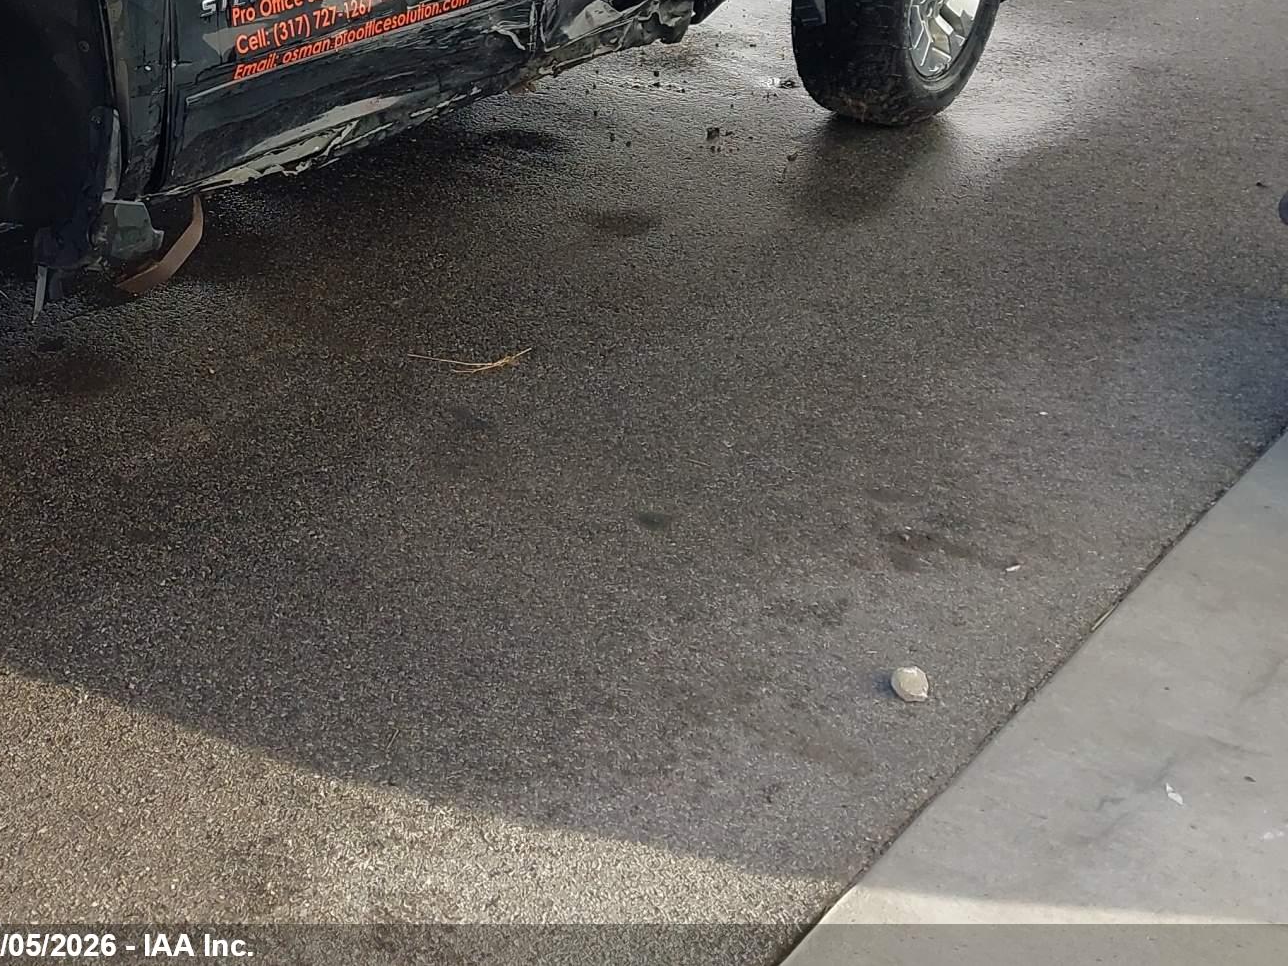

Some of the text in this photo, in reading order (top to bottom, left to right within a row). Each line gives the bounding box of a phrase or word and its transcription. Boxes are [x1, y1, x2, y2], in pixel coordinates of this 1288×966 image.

[232, 6, 256, 27] Pro
[236, 27, 270, 54] Cell:
[272, 13, 310, 46] (317)
[233, 54, 279, 80] Email:
